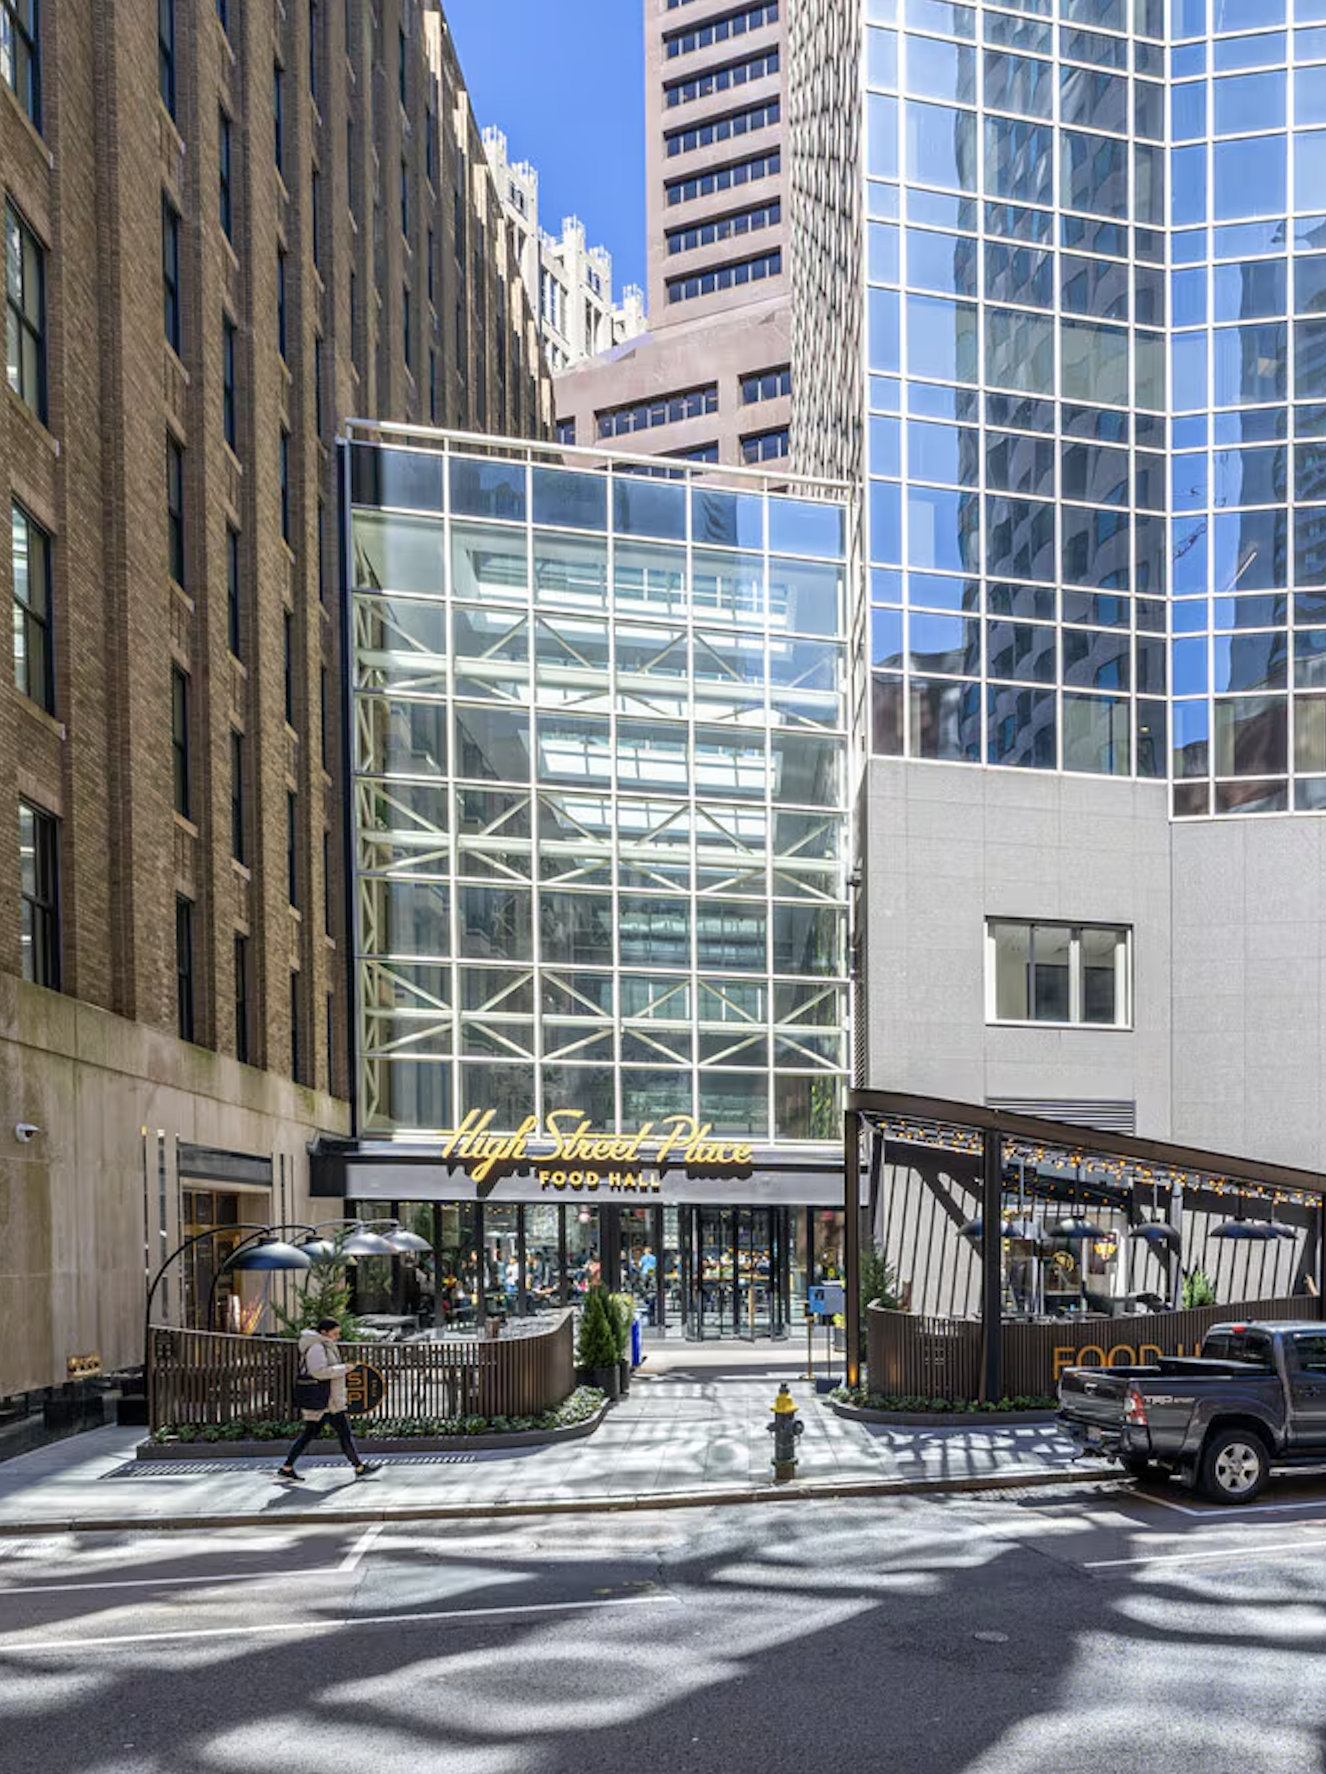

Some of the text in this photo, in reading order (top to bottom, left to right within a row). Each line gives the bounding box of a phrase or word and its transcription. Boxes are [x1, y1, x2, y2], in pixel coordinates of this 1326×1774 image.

[439, 1107, 752, 1182] High Street Place
[539, 1171, 661, 1188] FOOD HALL
[1053, 1343, 1163, 1381] FOOD
